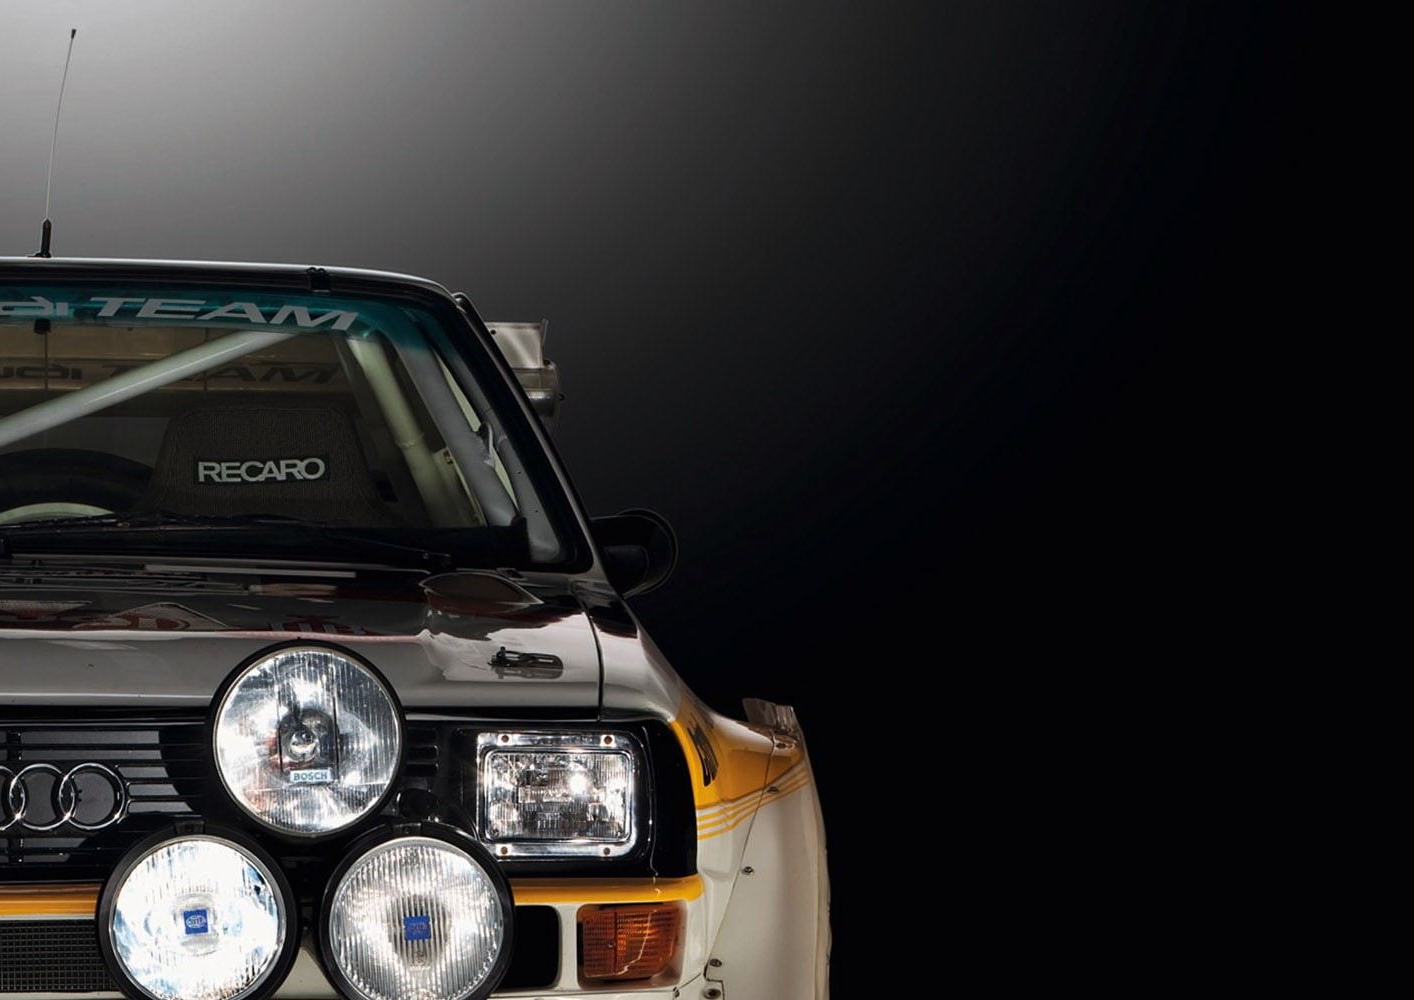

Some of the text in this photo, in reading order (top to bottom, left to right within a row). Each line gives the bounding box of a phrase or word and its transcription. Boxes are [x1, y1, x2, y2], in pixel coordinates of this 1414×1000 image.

[90, 297, 359, 330] TEAM
[101, 362, 339, 384] TAM
[198, 457, 326, 483] RECARO
[293, 771, 328, 781] BOSCH
